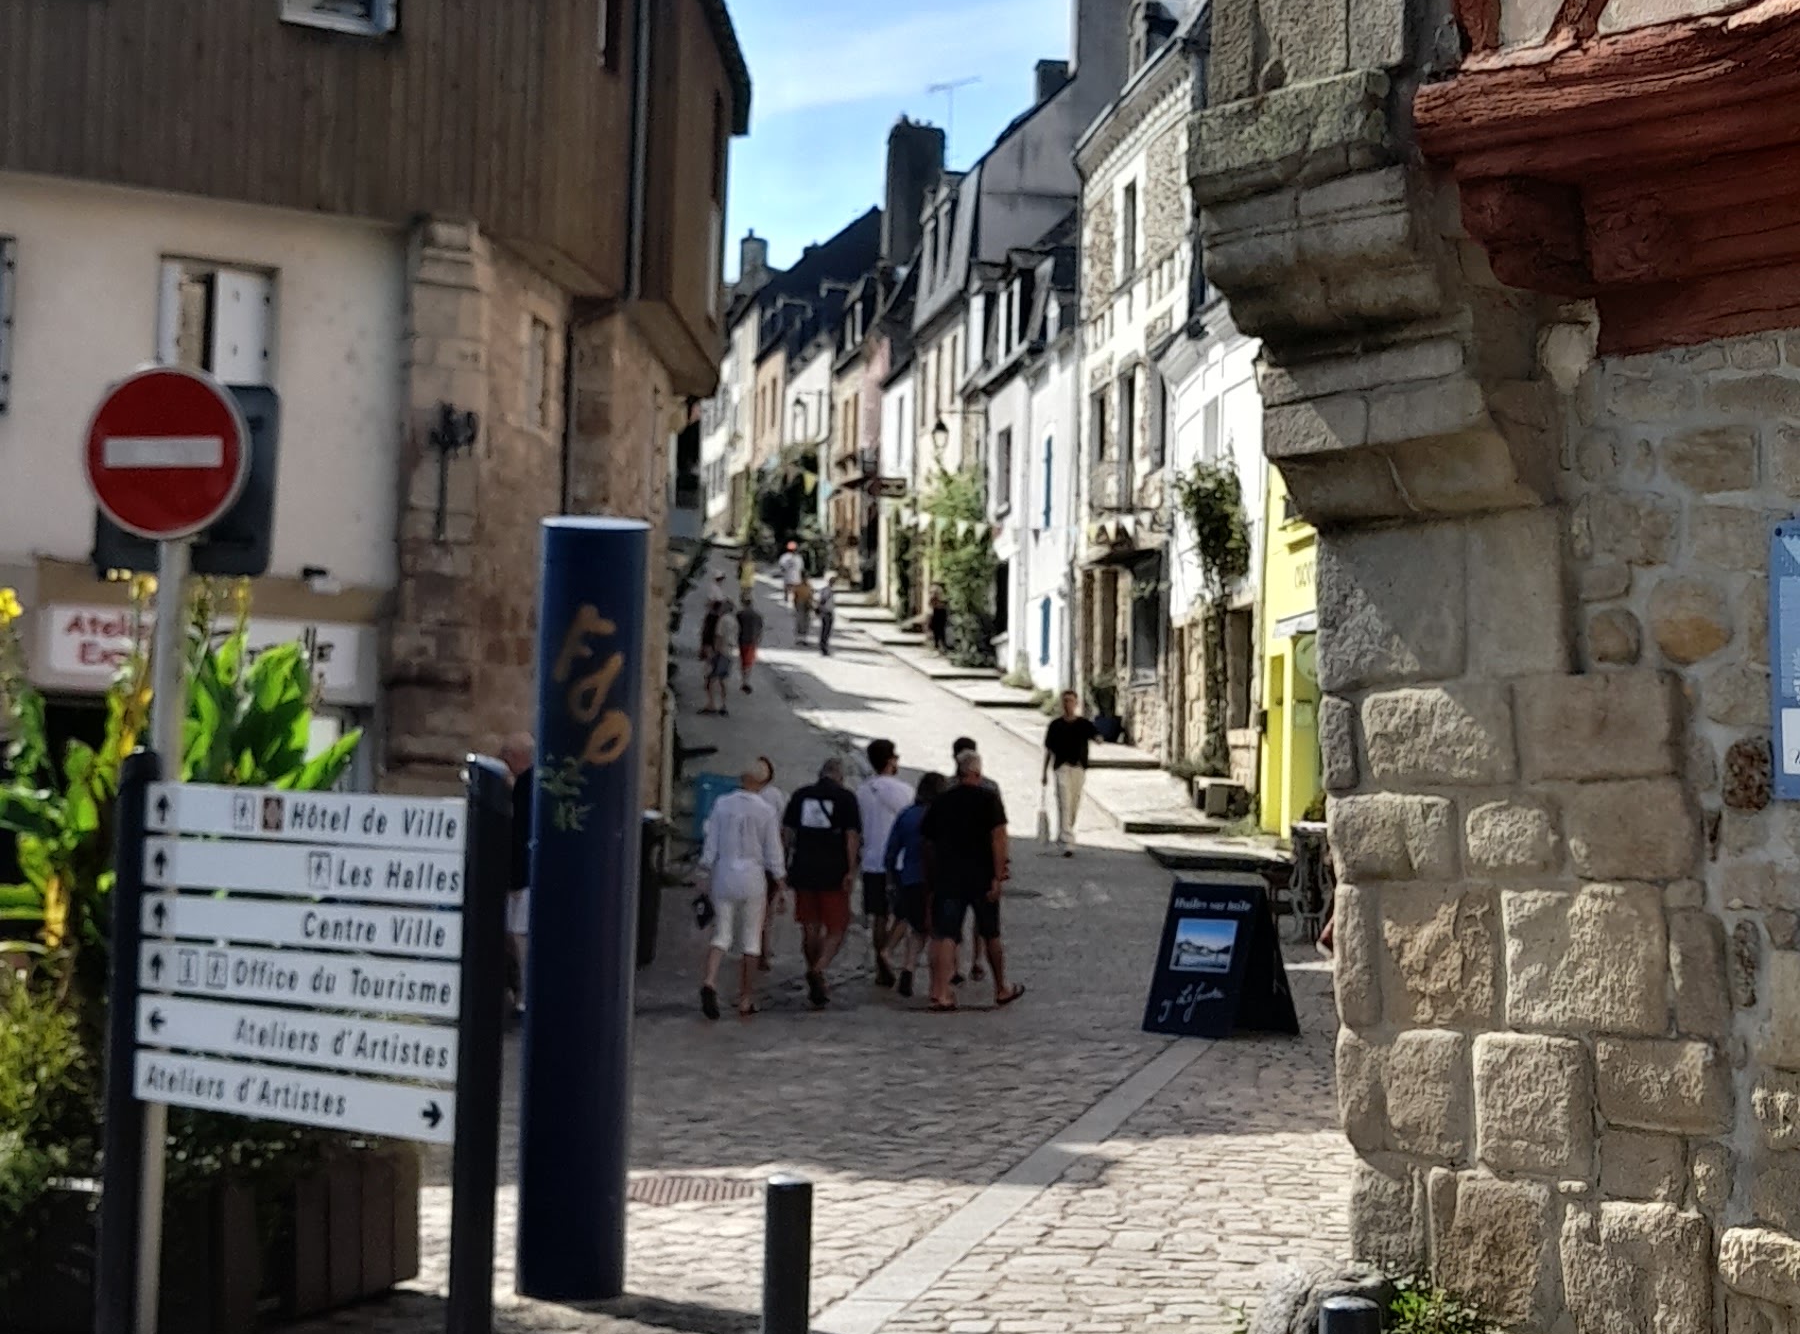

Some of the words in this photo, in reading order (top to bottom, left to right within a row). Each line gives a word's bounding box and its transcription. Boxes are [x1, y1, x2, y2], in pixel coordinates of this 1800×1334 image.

[290, 801, 351, 833] Hôtel
[362, 807, 388, 835] de
[403, 807, 458, 841] Ville
[337, 859, 374, 888] Les
[385, 859, 461, 893] Halles
[303, 911, 378, 943] Centre
[392, 916, 446, 948] Ville
[233, 958, 300, 992] Office
[311, 965, 337, 995] du
[351, 967, 452, 1006] Tourisme
[235, 1017, 321, 1055] Ateliers
[332, 1028, 450, 1069] d'Artistes
[145, 1065, 226, 1101] Ateliers
[233, 1076, 347, 1117] d'Artistes
